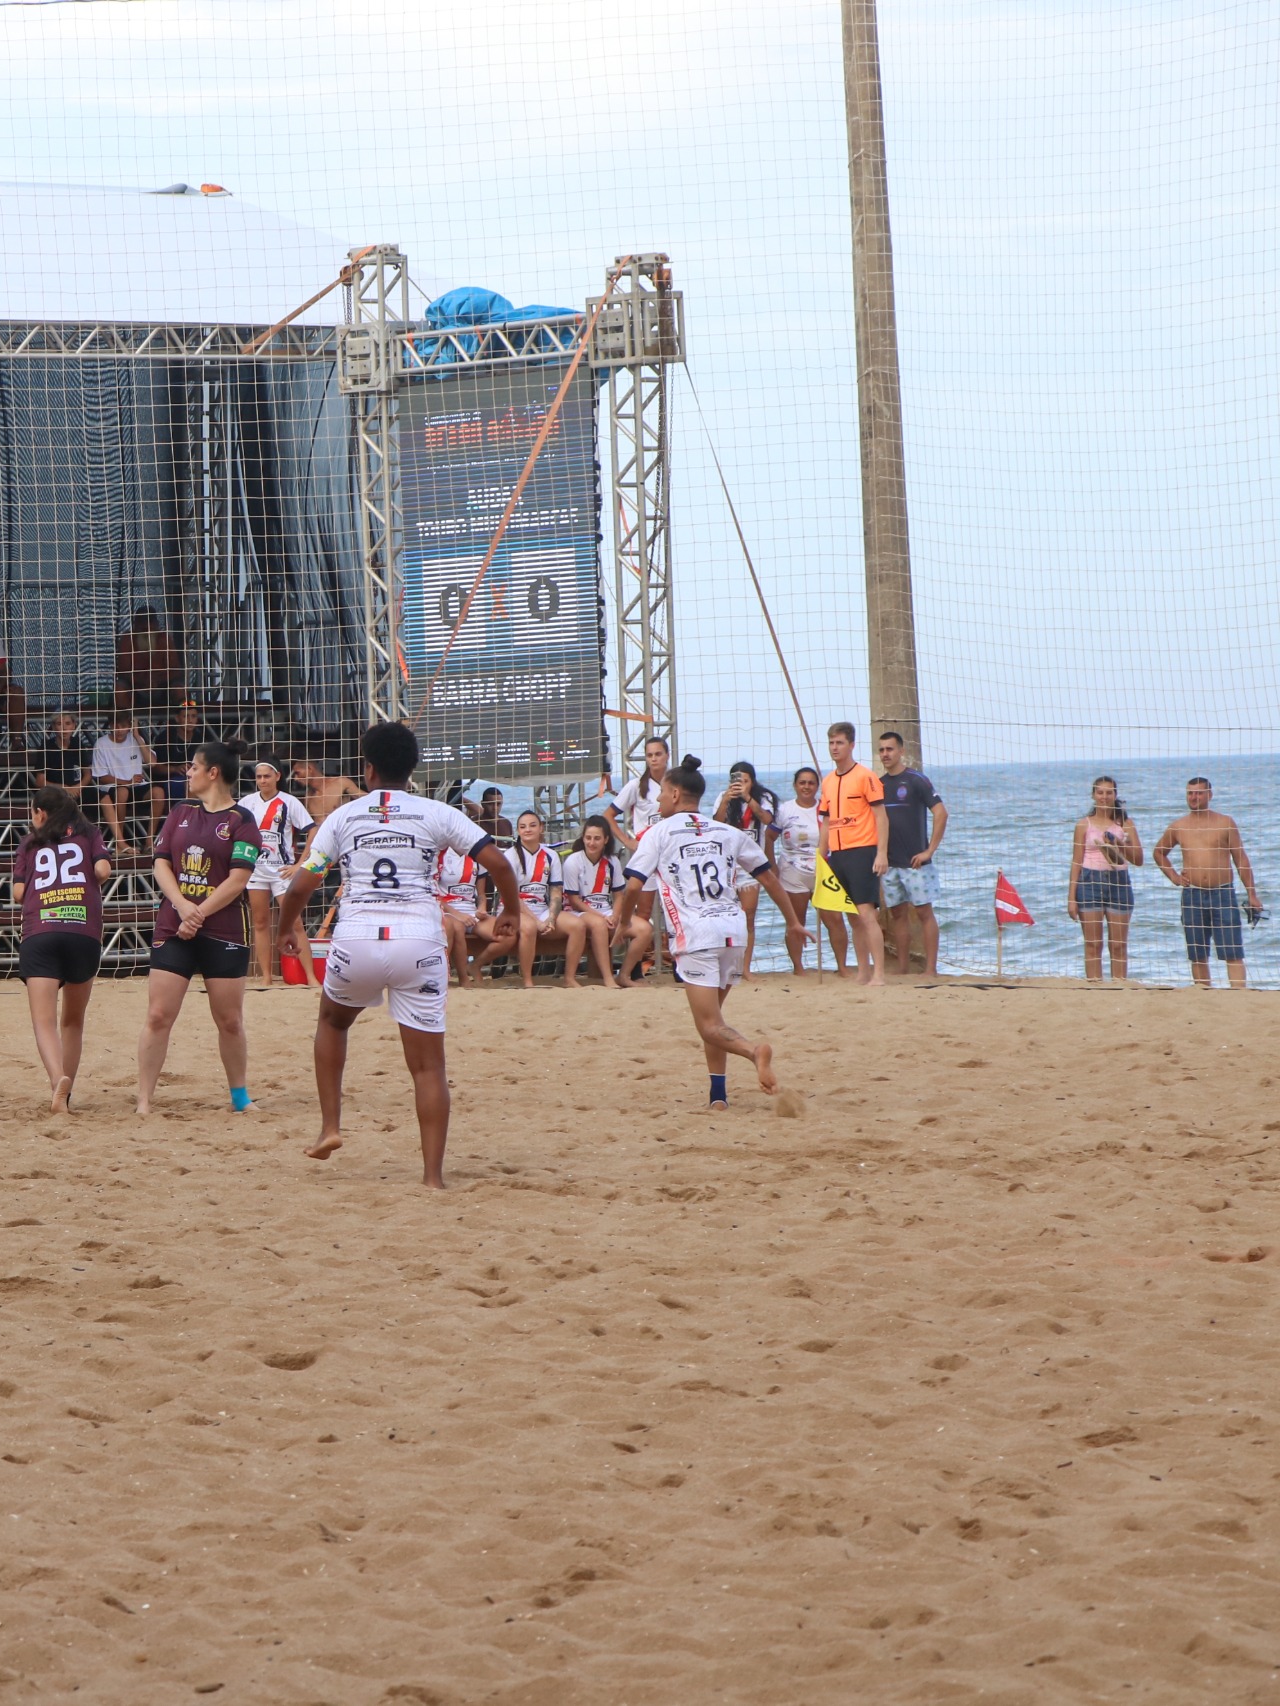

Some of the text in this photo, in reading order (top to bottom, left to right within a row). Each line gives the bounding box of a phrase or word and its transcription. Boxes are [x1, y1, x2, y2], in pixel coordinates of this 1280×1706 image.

[440, 583, 470, 629] 0
[528, 575, 561, 622] 0
[433, 672, 572, 706] BARRA CHOPP
[244, 845, 254, 857] C
[361, 836, 408, 847] SERAFIM
[34, 842, 87, 890] 92
[179, 872, 208, 885] BARRA
[371, 857, 400, 889] 8
[690, 861, 724, 901] 13
[180, 882, 217, 897] HOPP
